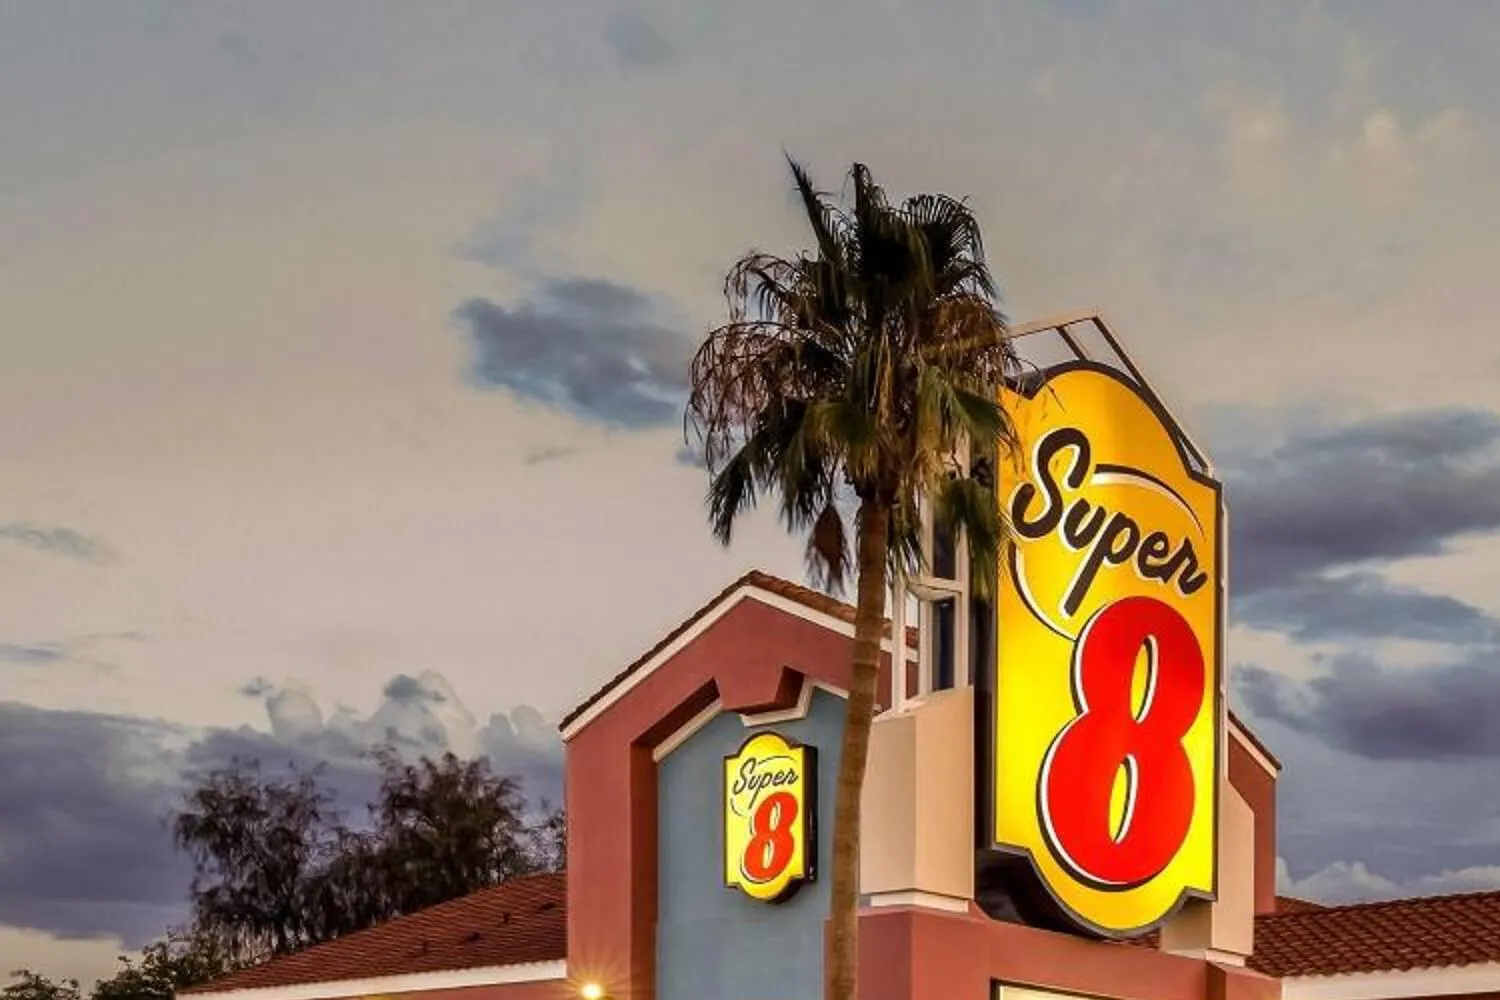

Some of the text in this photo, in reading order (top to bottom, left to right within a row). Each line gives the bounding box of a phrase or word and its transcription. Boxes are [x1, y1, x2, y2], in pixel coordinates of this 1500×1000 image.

[1011, 427, 1208, 618] Super
[732, 757, 799, 809] Super
[1036, 596, 1205, 891] 8
[740, 791, 799, 884] 8
